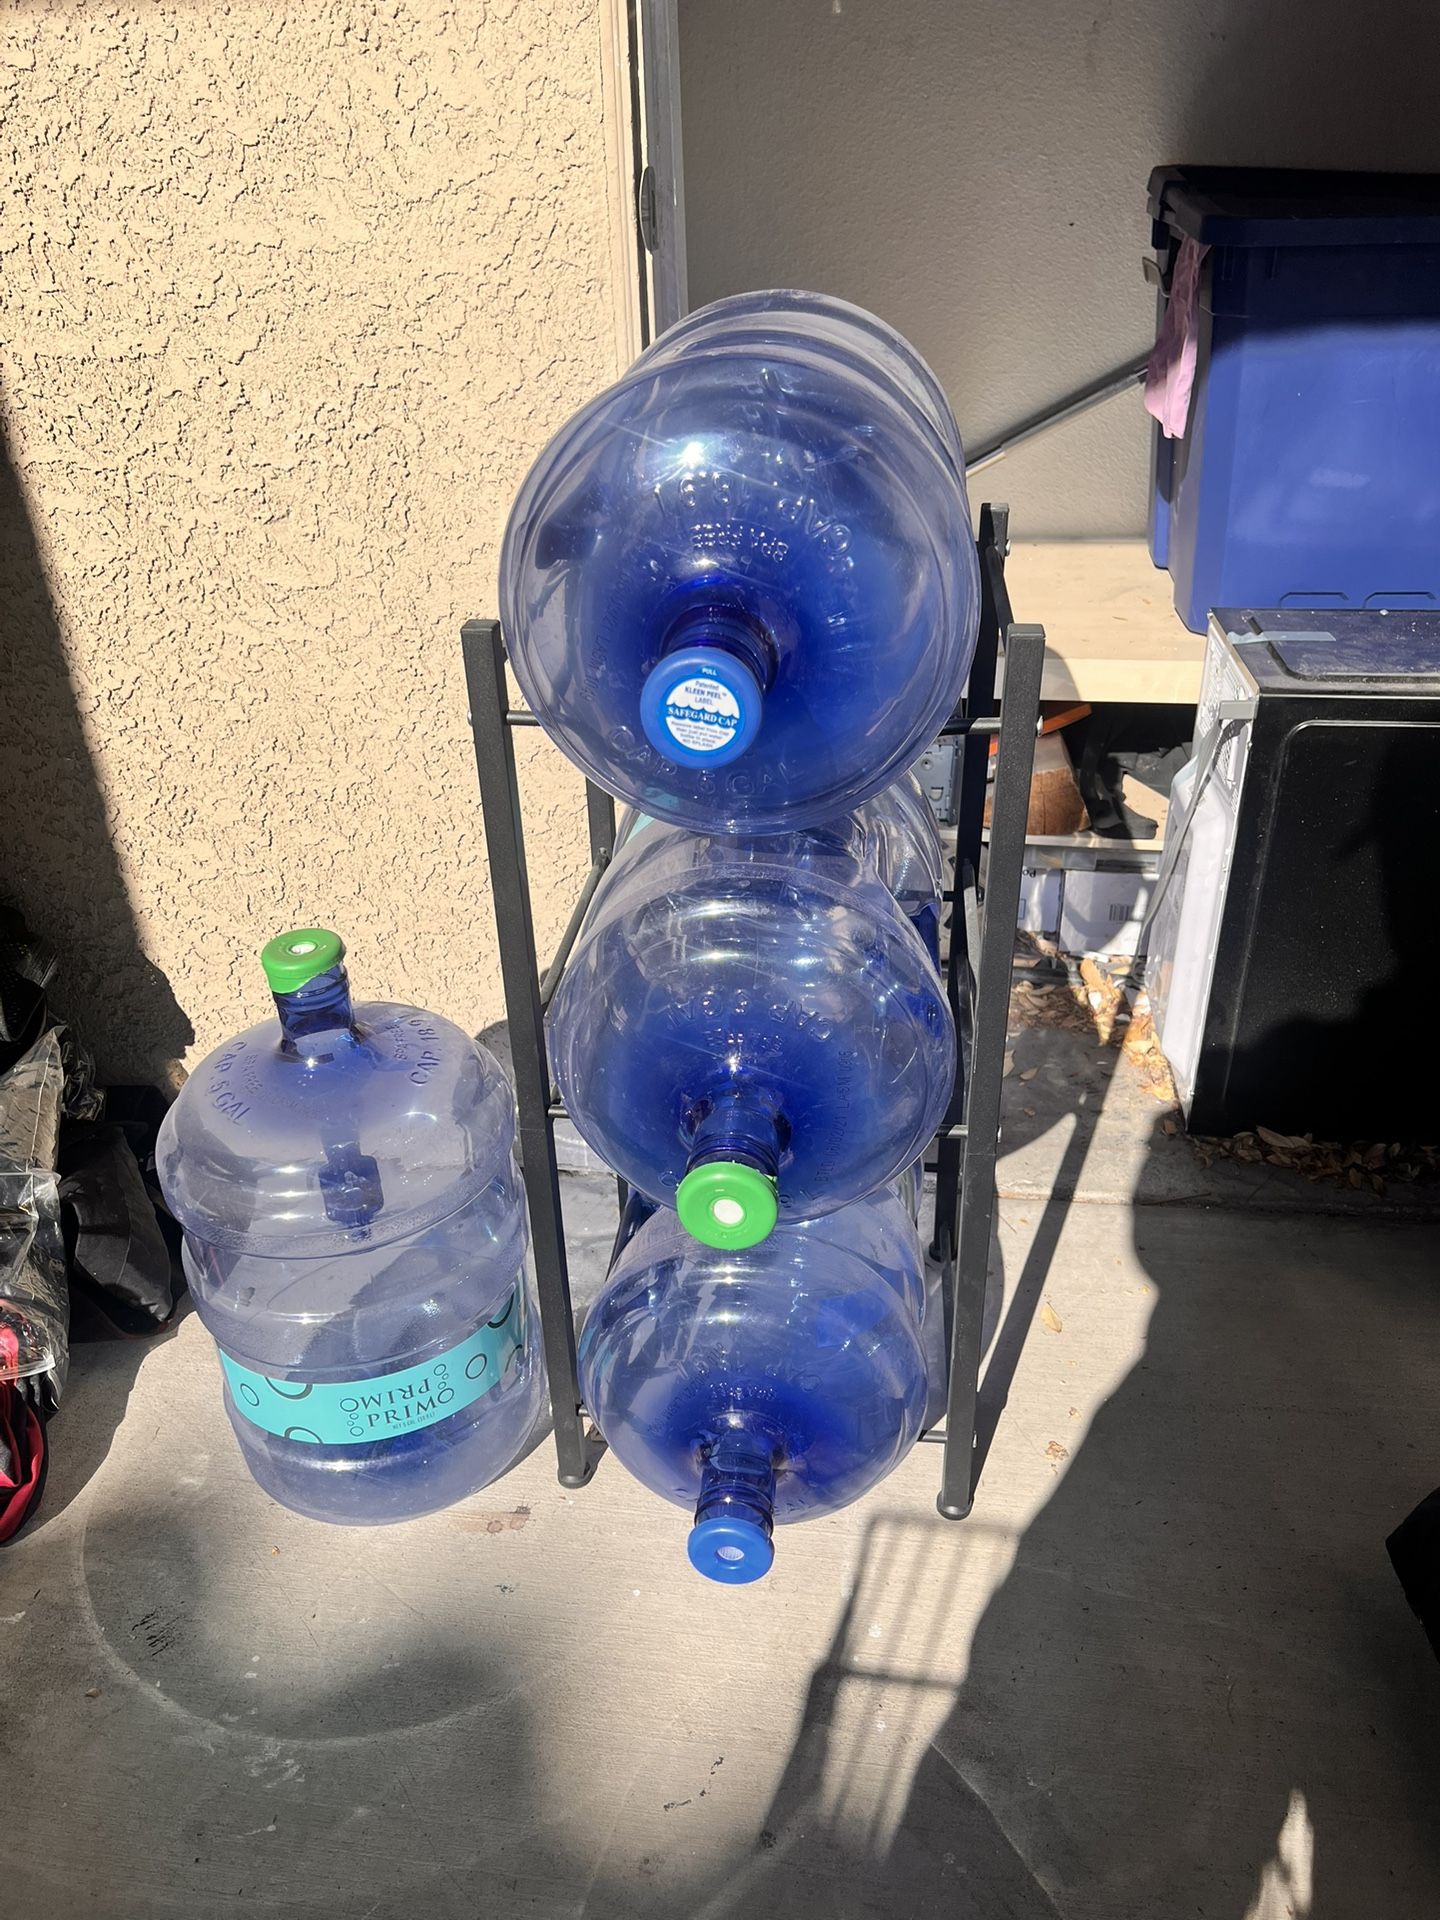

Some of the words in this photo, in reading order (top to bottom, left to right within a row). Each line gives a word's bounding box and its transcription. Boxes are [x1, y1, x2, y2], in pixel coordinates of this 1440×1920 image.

[701, 666, 718, 676] PULL
[684, 686, 705, 696] KLEEN
[694, 697, 713, 706] LABEL
[667, 706, 718, 724] SAFEGARD
[718, 716, 738, 727] CAP
[701, 769, 717, 795] 5
[725, 758, 808, 798] GAL
[212, 1091, 251, 1126] GAL
[340, 1378, 432, 1413] PRIMO
[367, 1387, 455, 1428] PRIMO
